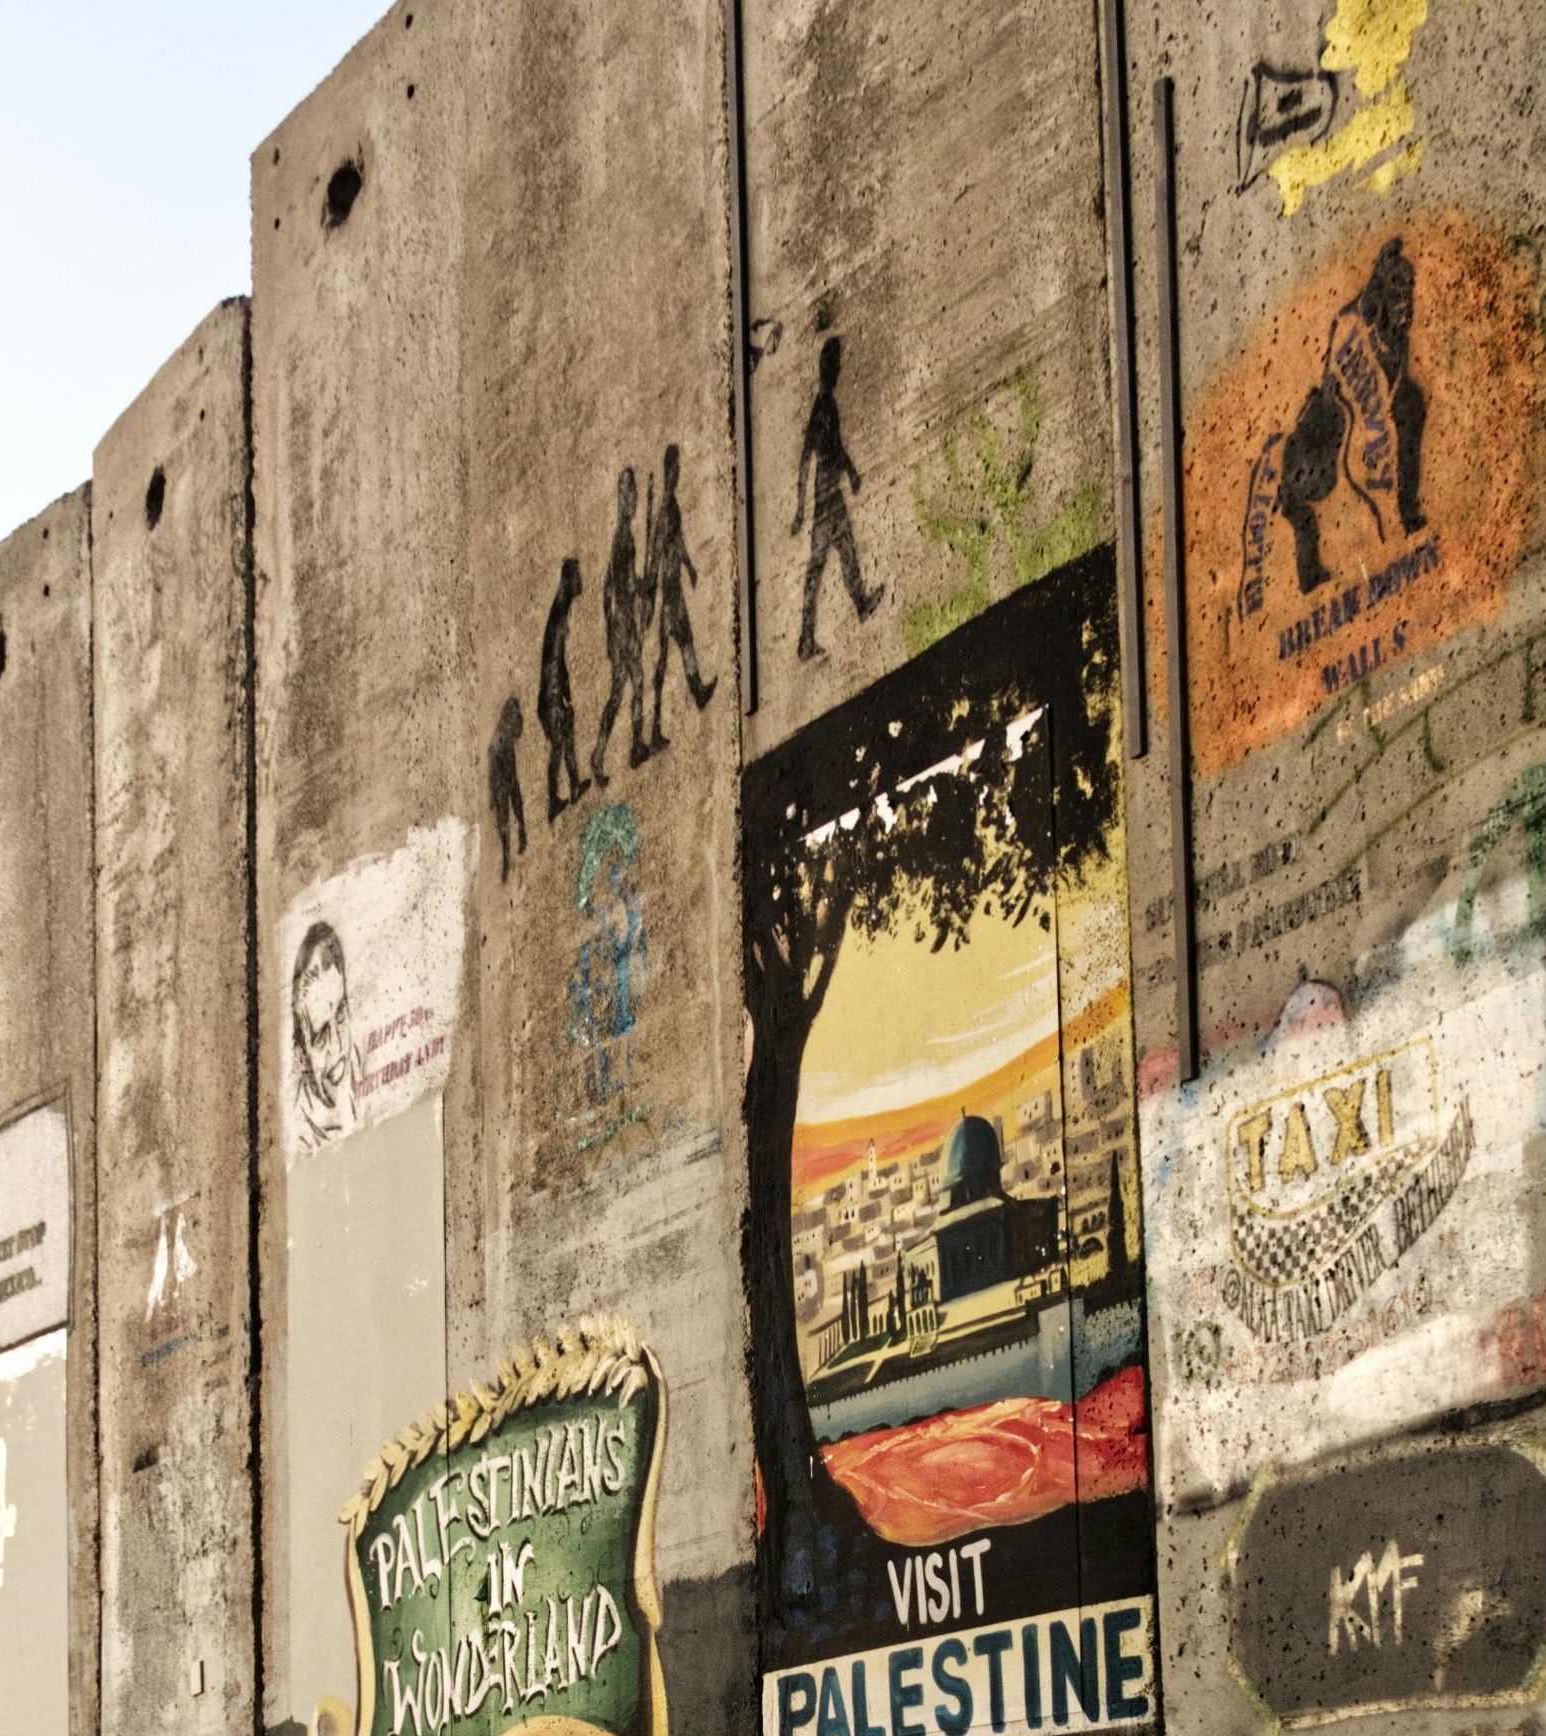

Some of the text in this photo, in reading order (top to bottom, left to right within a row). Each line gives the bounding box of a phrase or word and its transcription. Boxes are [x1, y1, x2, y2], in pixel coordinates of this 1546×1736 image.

[1278, 535, 1441, 661] BREAK DOWN
[1321, 620, 1408, 696] WALLS
[1238, 1070, 1395, 1193] TAXI
[370, 1411, 627, 1614] PALESTINIANS
[486, 1537, 535, 1621] IN
[886, 1538, 991, 1628] VISIT
